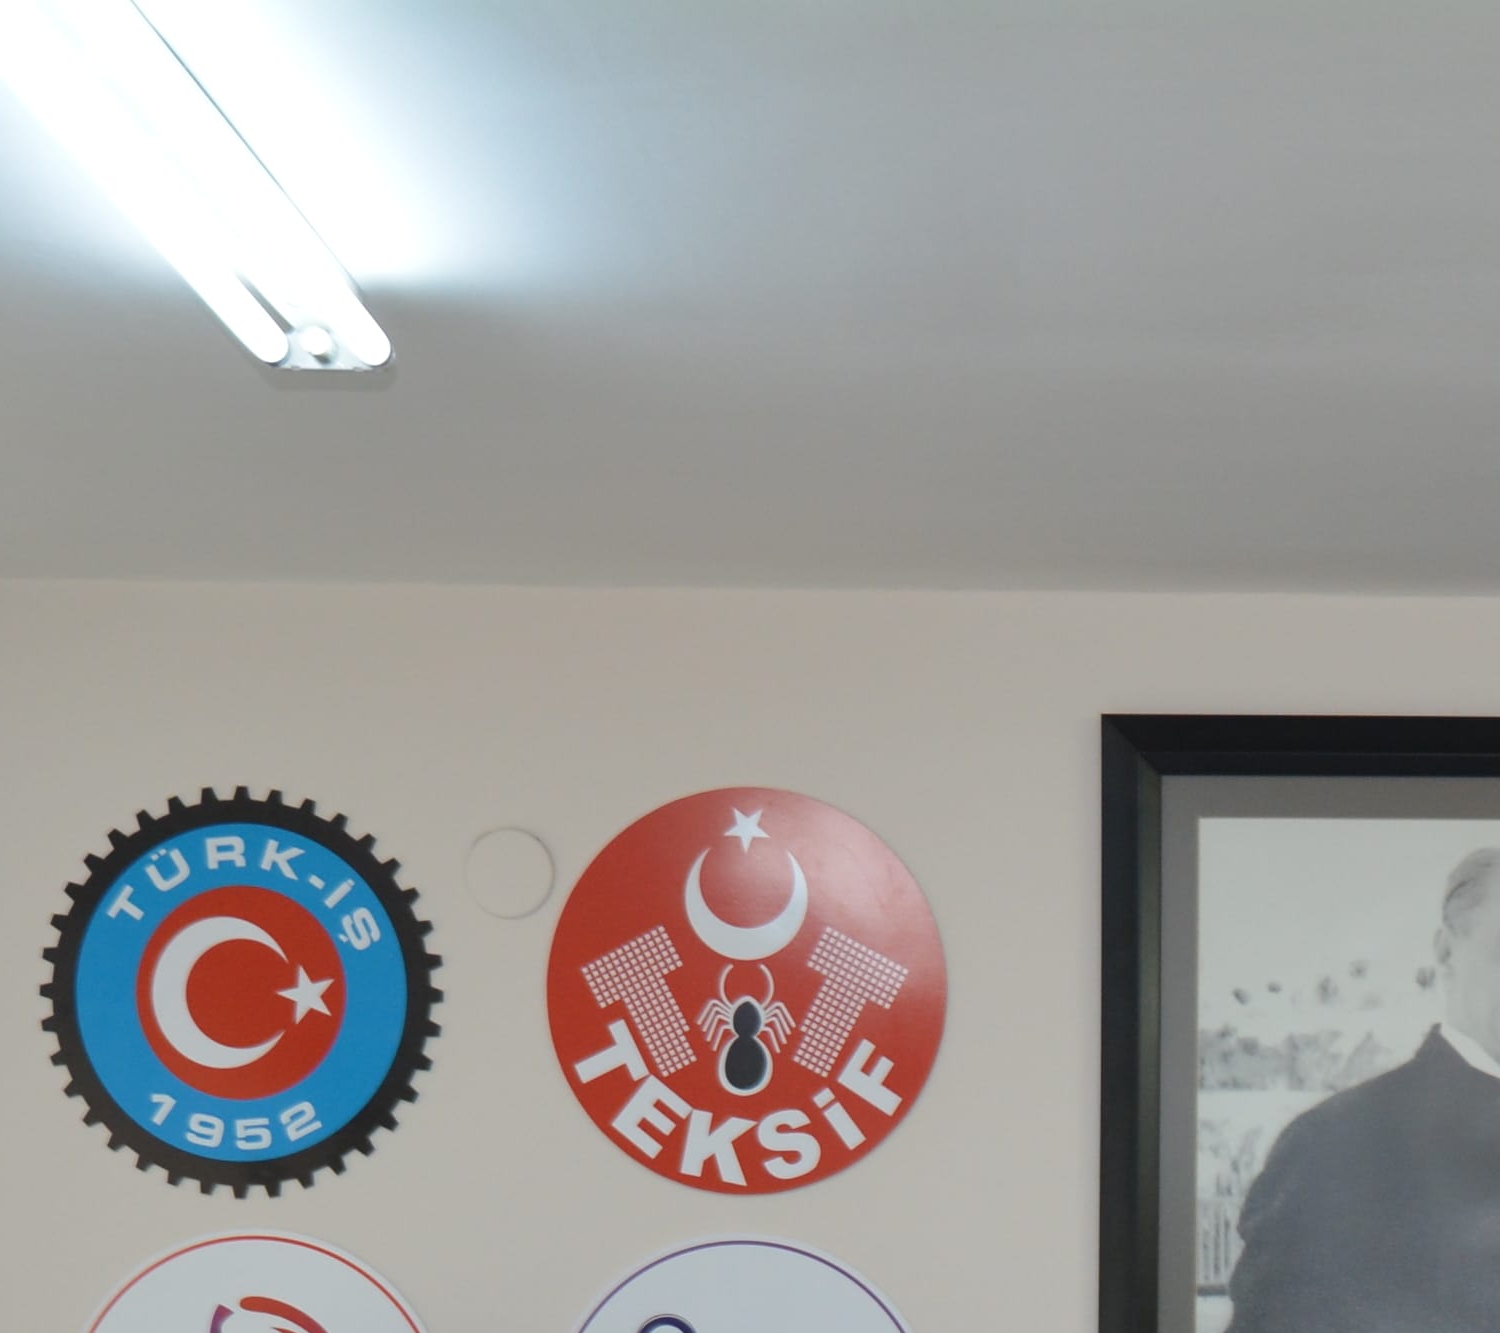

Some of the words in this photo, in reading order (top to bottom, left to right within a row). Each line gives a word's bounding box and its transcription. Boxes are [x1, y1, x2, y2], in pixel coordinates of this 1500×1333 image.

[107, 835, 381, 953] TÜRK-İŞ
[148, 1093, 322, 1151] 1952
[574, 1020, 903, 1187] TEKSİF
